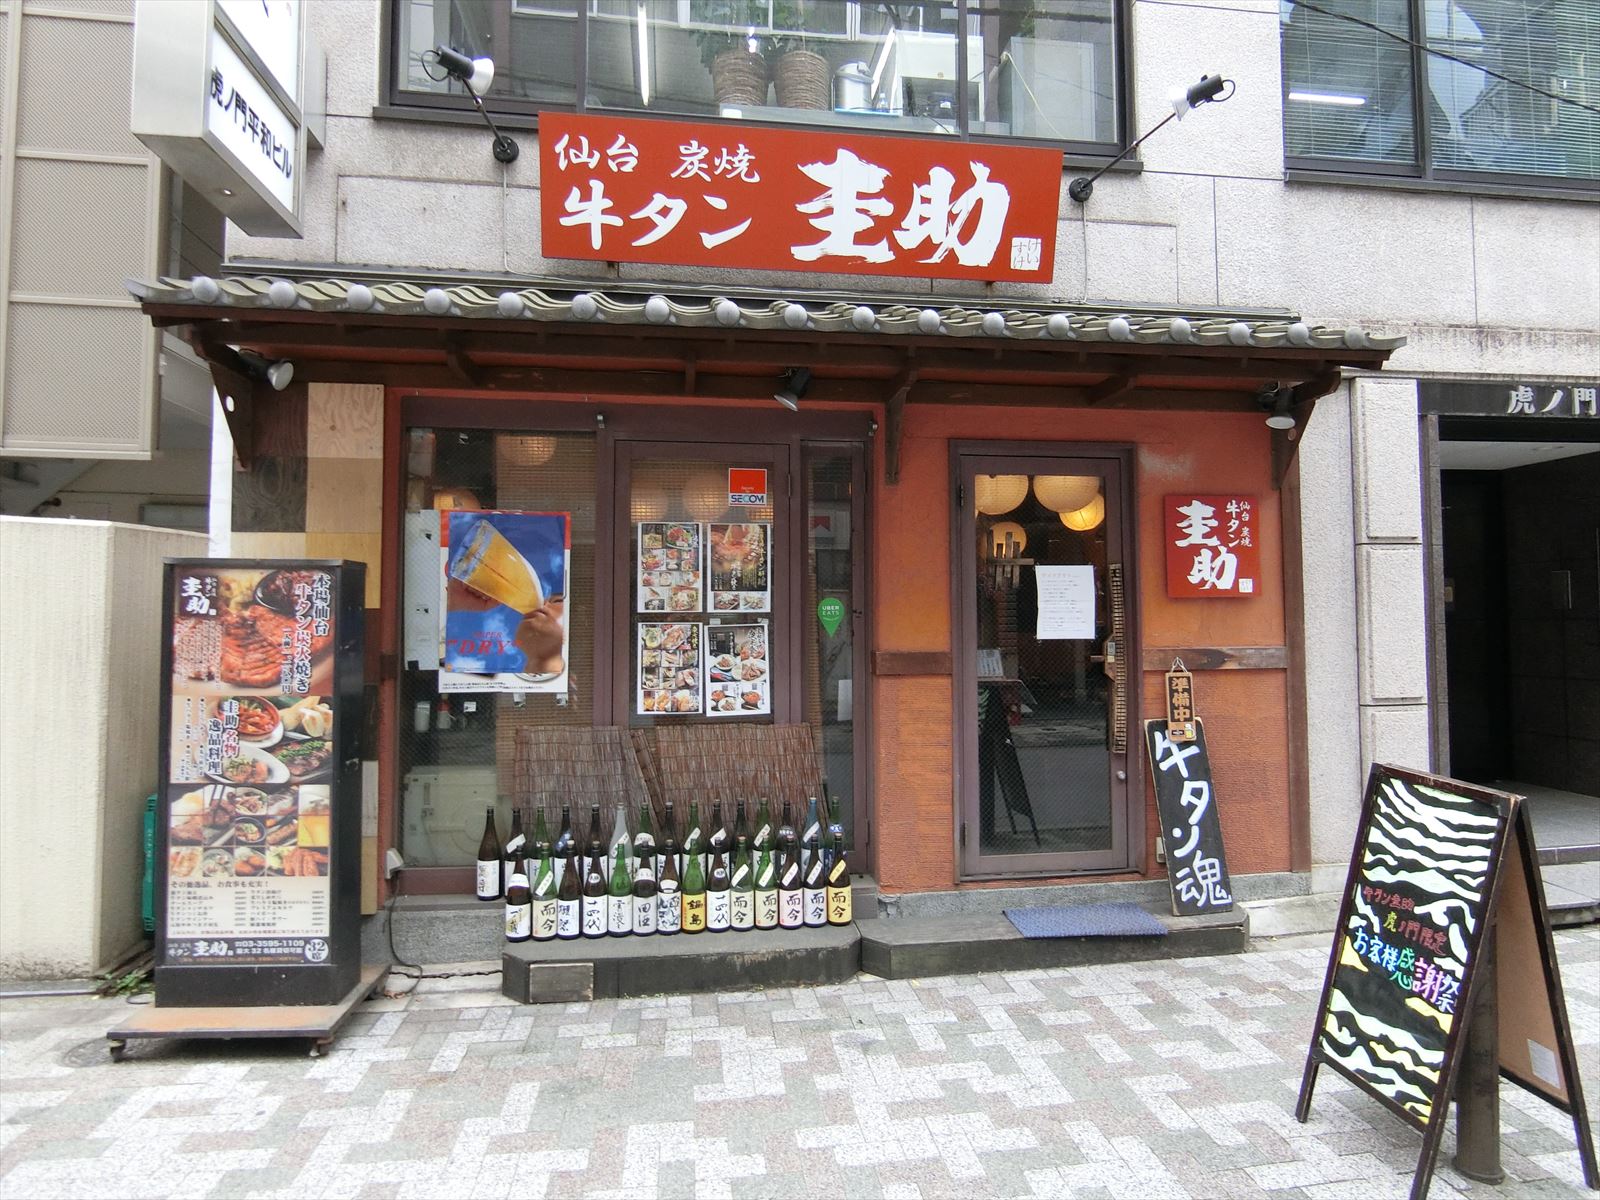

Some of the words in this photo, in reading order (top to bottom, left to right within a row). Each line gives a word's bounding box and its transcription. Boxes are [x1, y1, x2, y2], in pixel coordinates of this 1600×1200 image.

[210, 65, 292, 179] 虎ノ門平和ビル
[554, 134, 639, 174] 仙台
[670, 139, 760, 183] 炭焼
[559, 179, 752, 251] 牛タン
[790, 148, 1011, 267] 圭助
[1507, 385, 1597, 415] 虎ノ門
[731, 494, 764, 503] SECOM
[1225, 500, 1241, 548] 牛タン
[1174, 499, 1238, 590] 圭助
[181, 576, 210, 614] 圭助
[1172, 677, 1190, 721] 準備中
[1154, 730, 1232, 908] 牛タン魂
[541, 903, 555, 931] 而今
[687, 900, 703, 926] 鍋島
[733, 896, 747, 923] 而今
[763, 894, 777, 921] 而今
[786, 894, 801, 921] 而今
[810, 892, 824, 919] 而今
[831, 891, 846, 918] 而今
[308, 941, 326, 951] 32
[1353, 927, 1460, 1013] お客様感謝祭
